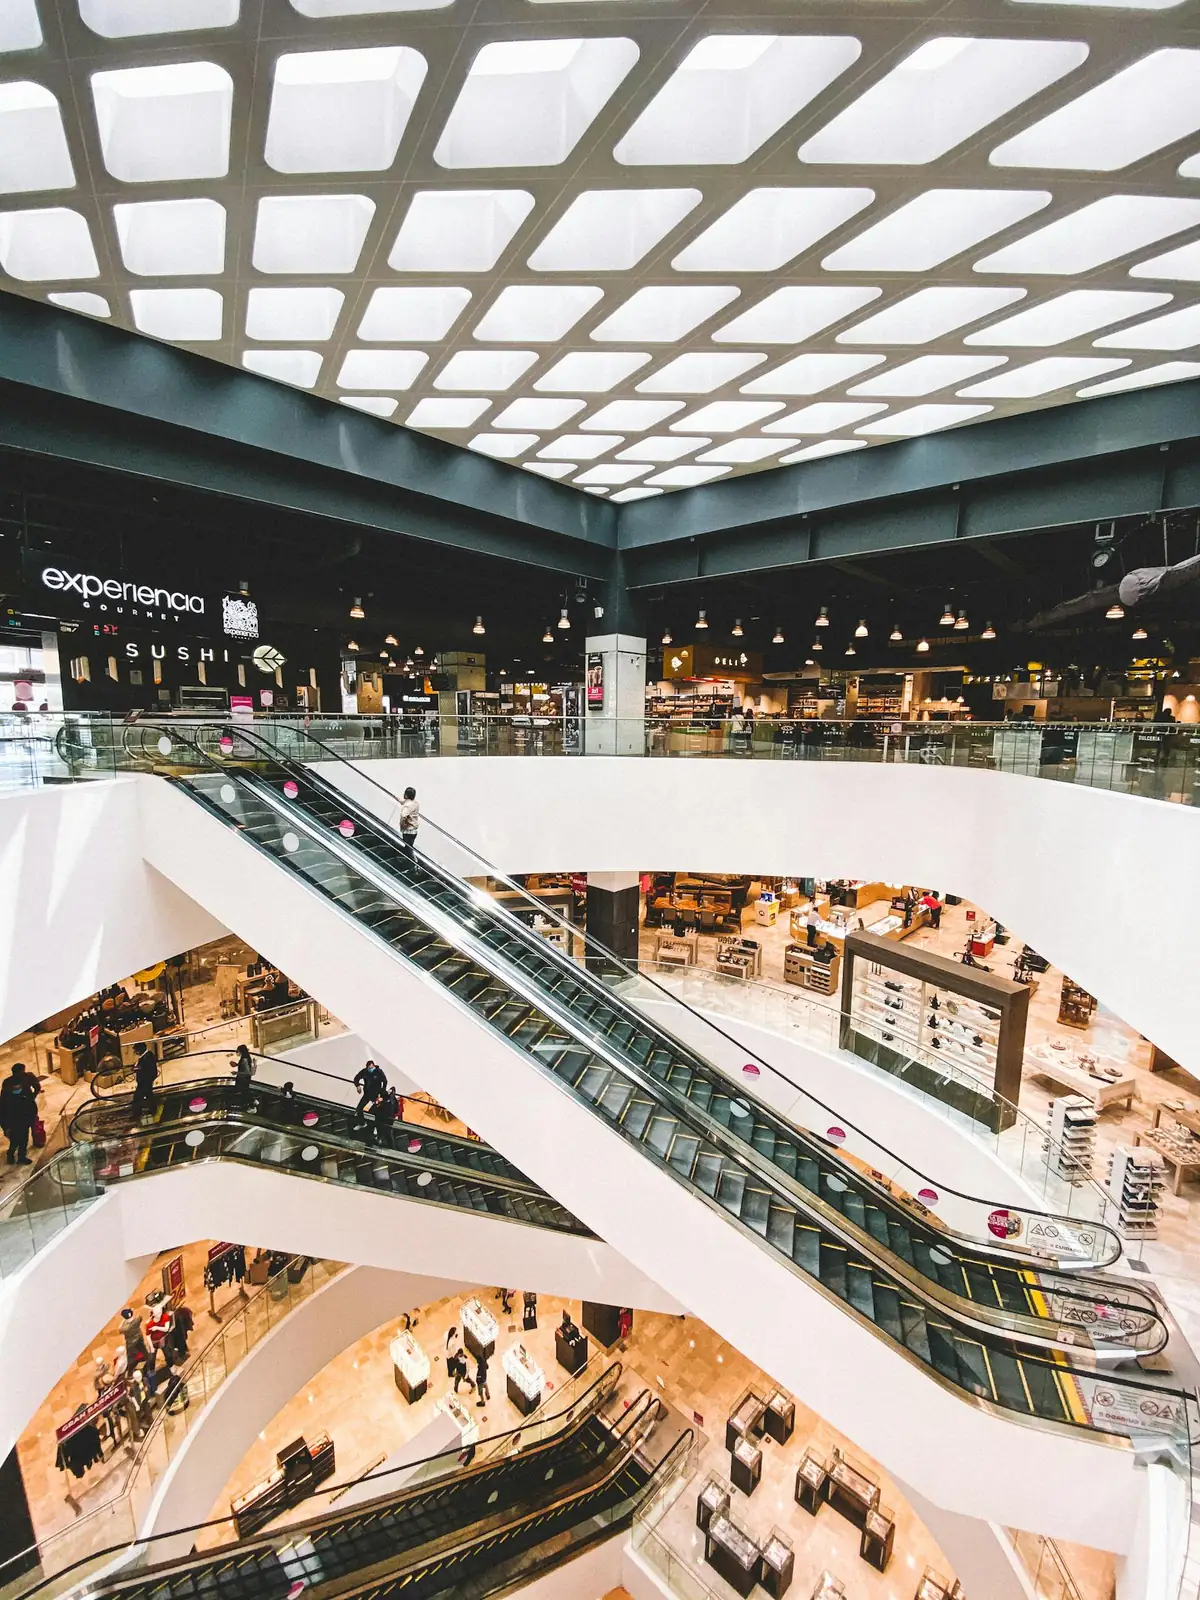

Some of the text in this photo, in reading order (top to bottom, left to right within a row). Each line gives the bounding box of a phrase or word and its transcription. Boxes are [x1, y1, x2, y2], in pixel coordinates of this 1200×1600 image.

[42, 568, 205, 614] experiencia
[83, 601, 180, 622] GOURMET
[125, 643, 229, 662] SUSHI
[714, 656, 738, 666] DELI
[87, 1387, 120, 1414] BARATA
